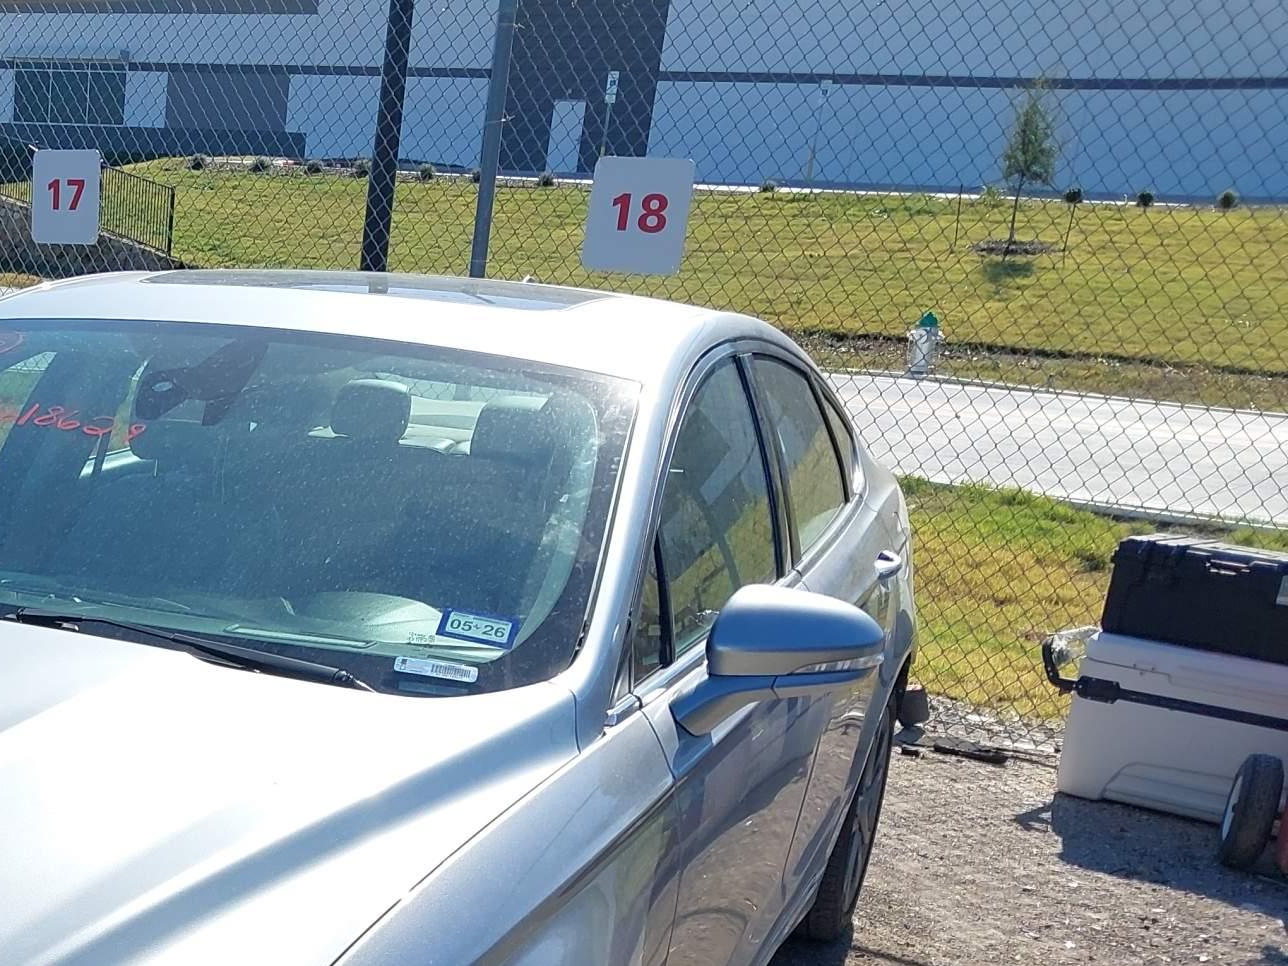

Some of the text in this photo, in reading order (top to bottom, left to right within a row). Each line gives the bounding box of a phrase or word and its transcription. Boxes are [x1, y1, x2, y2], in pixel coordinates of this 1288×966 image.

[48, 179, 85, 210] 17
[613, 193, 668, 233] 18
[450, 618, 472, 632] 05
[482, 624, 506, 638] 26
